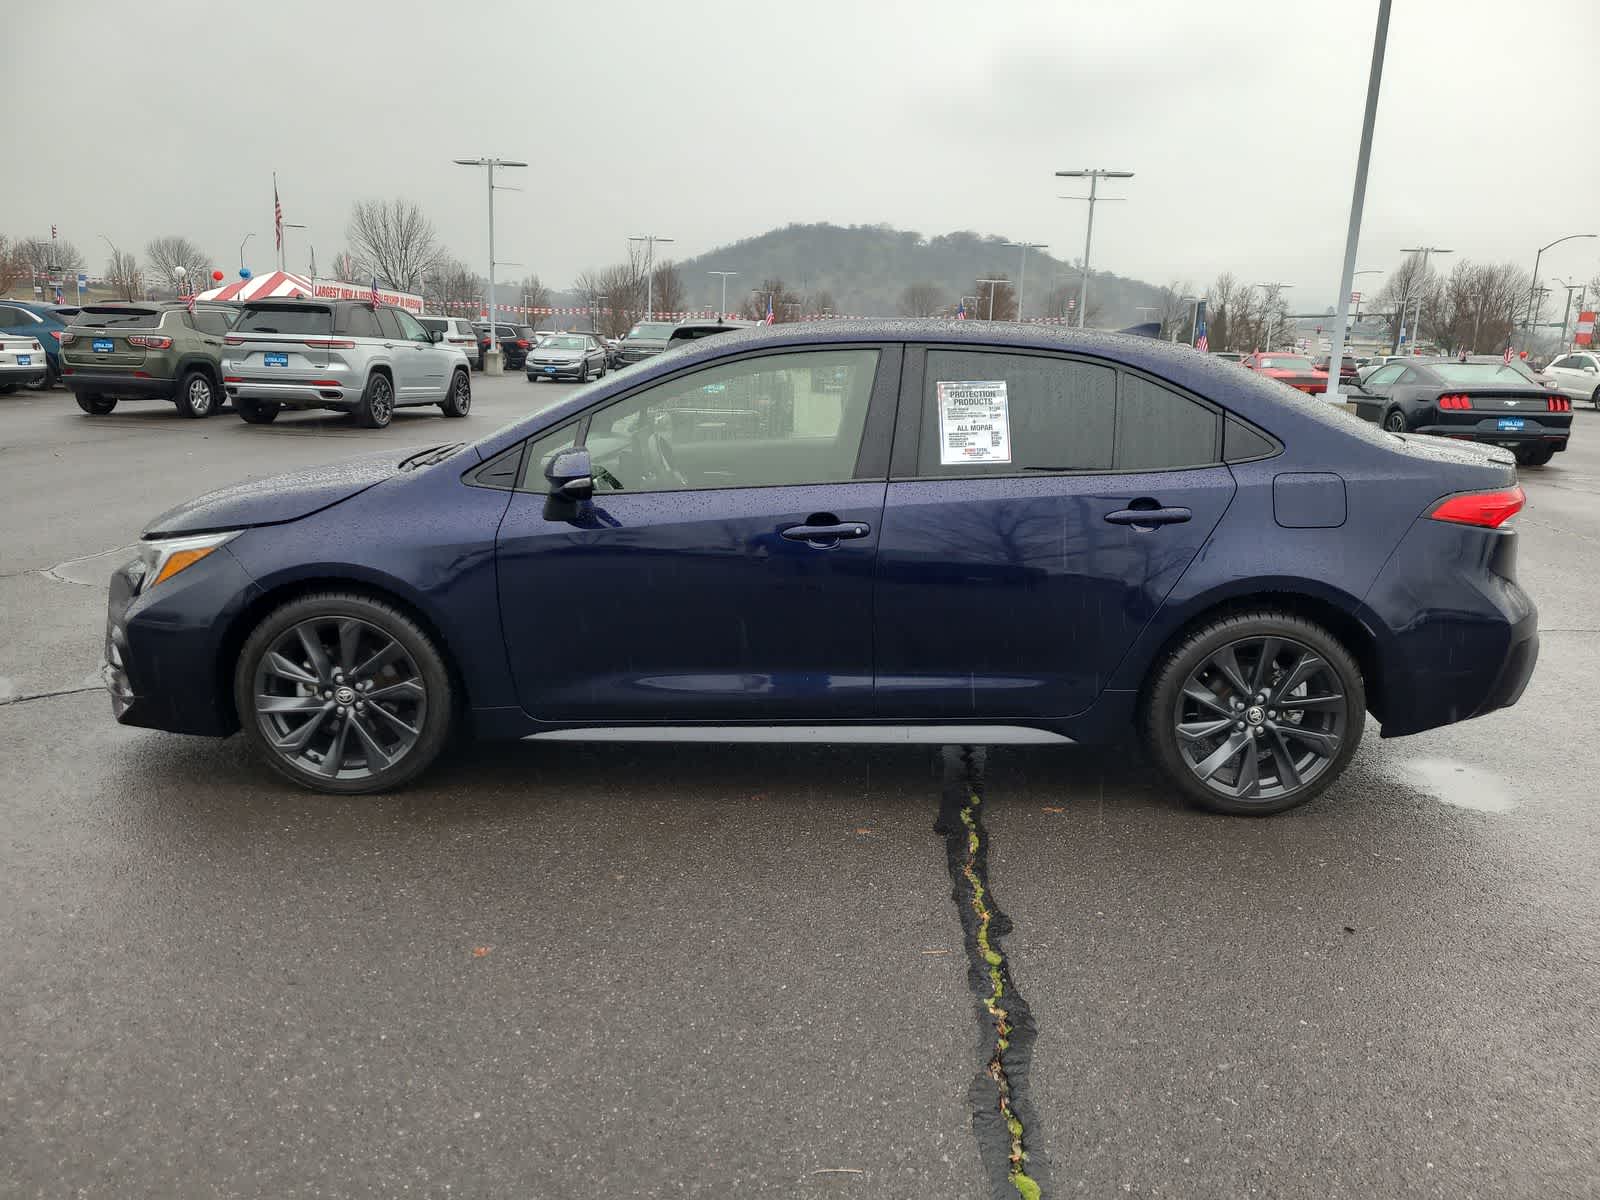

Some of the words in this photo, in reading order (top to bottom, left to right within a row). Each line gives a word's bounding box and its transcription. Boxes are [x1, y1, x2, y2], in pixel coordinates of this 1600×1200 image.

[315, 286, 340, 298] LARGEST
[341, 288, 352, 299] NEW
[954, 398, 993, 406] PRODUCTS
